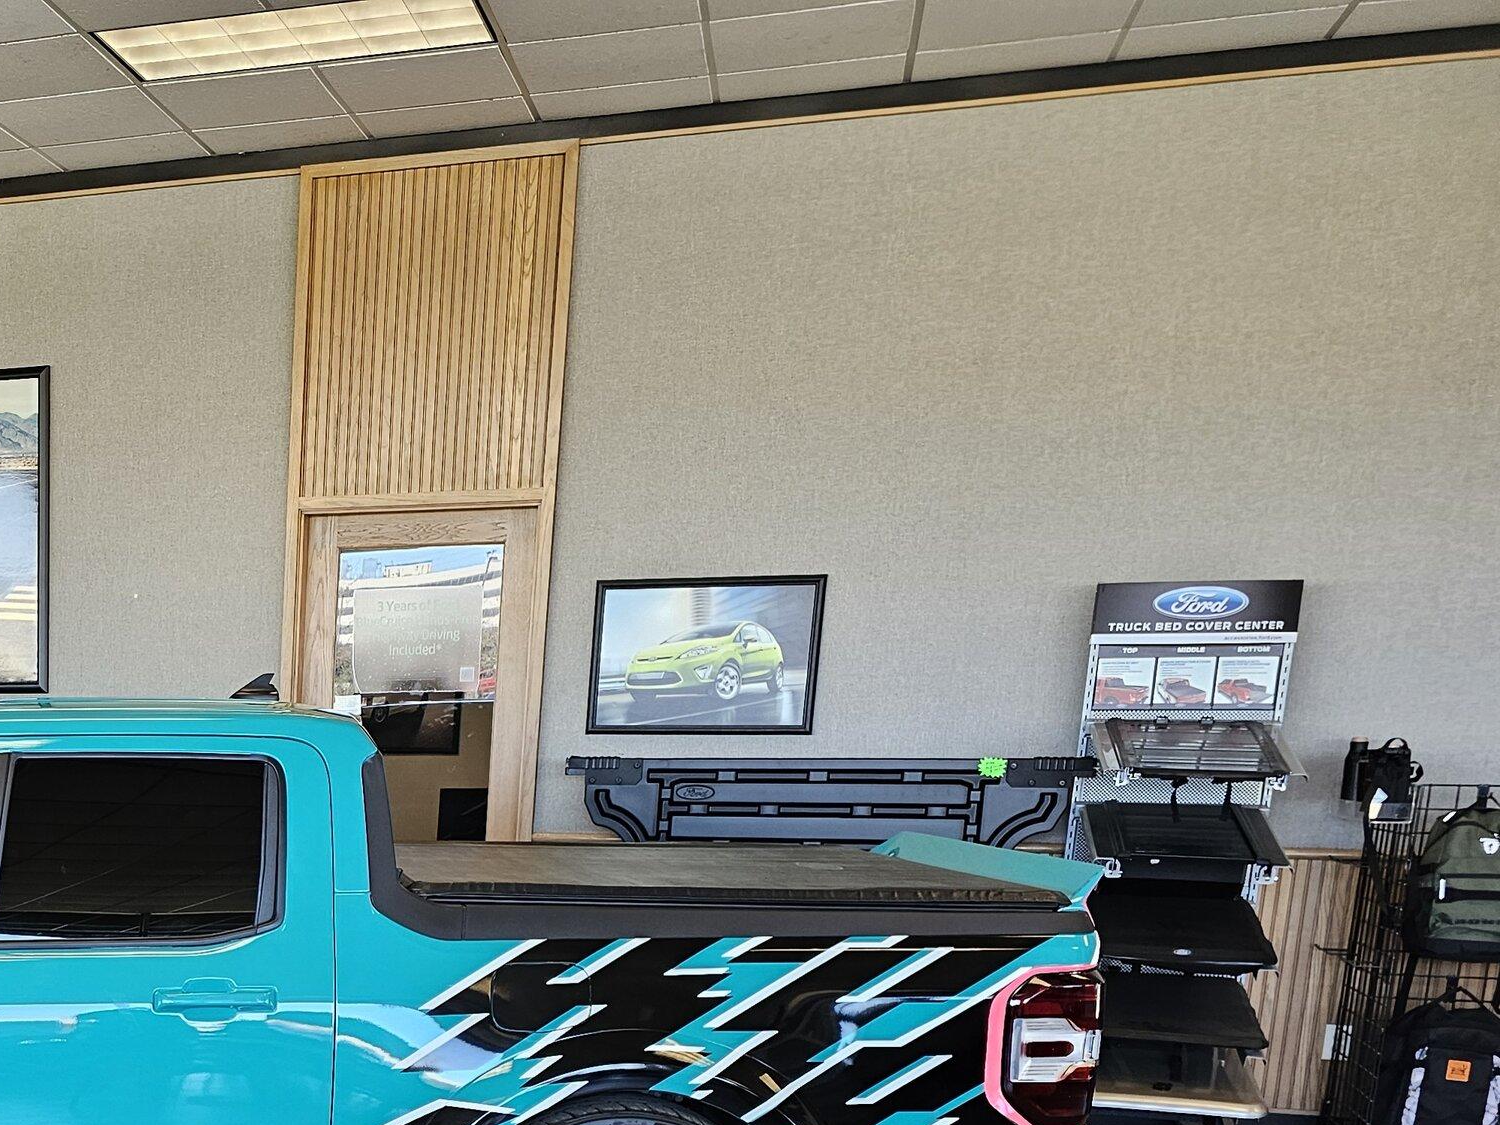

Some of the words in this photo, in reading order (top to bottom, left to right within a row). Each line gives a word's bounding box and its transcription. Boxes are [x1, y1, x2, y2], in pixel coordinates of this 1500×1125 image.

[377, 601, 384, 612] 3
[386, 600, 418, 612] Years
[1171, 591, 1229, 614] Ford
[1107, 622, 1151, 632] TRUCK
[1154, 621, 1182, 631] BED
[1185, 621, 1232, 631] COVER
[1234, 620, 1285, 631] CENTER
[420, 628, 460, 642] Driving
